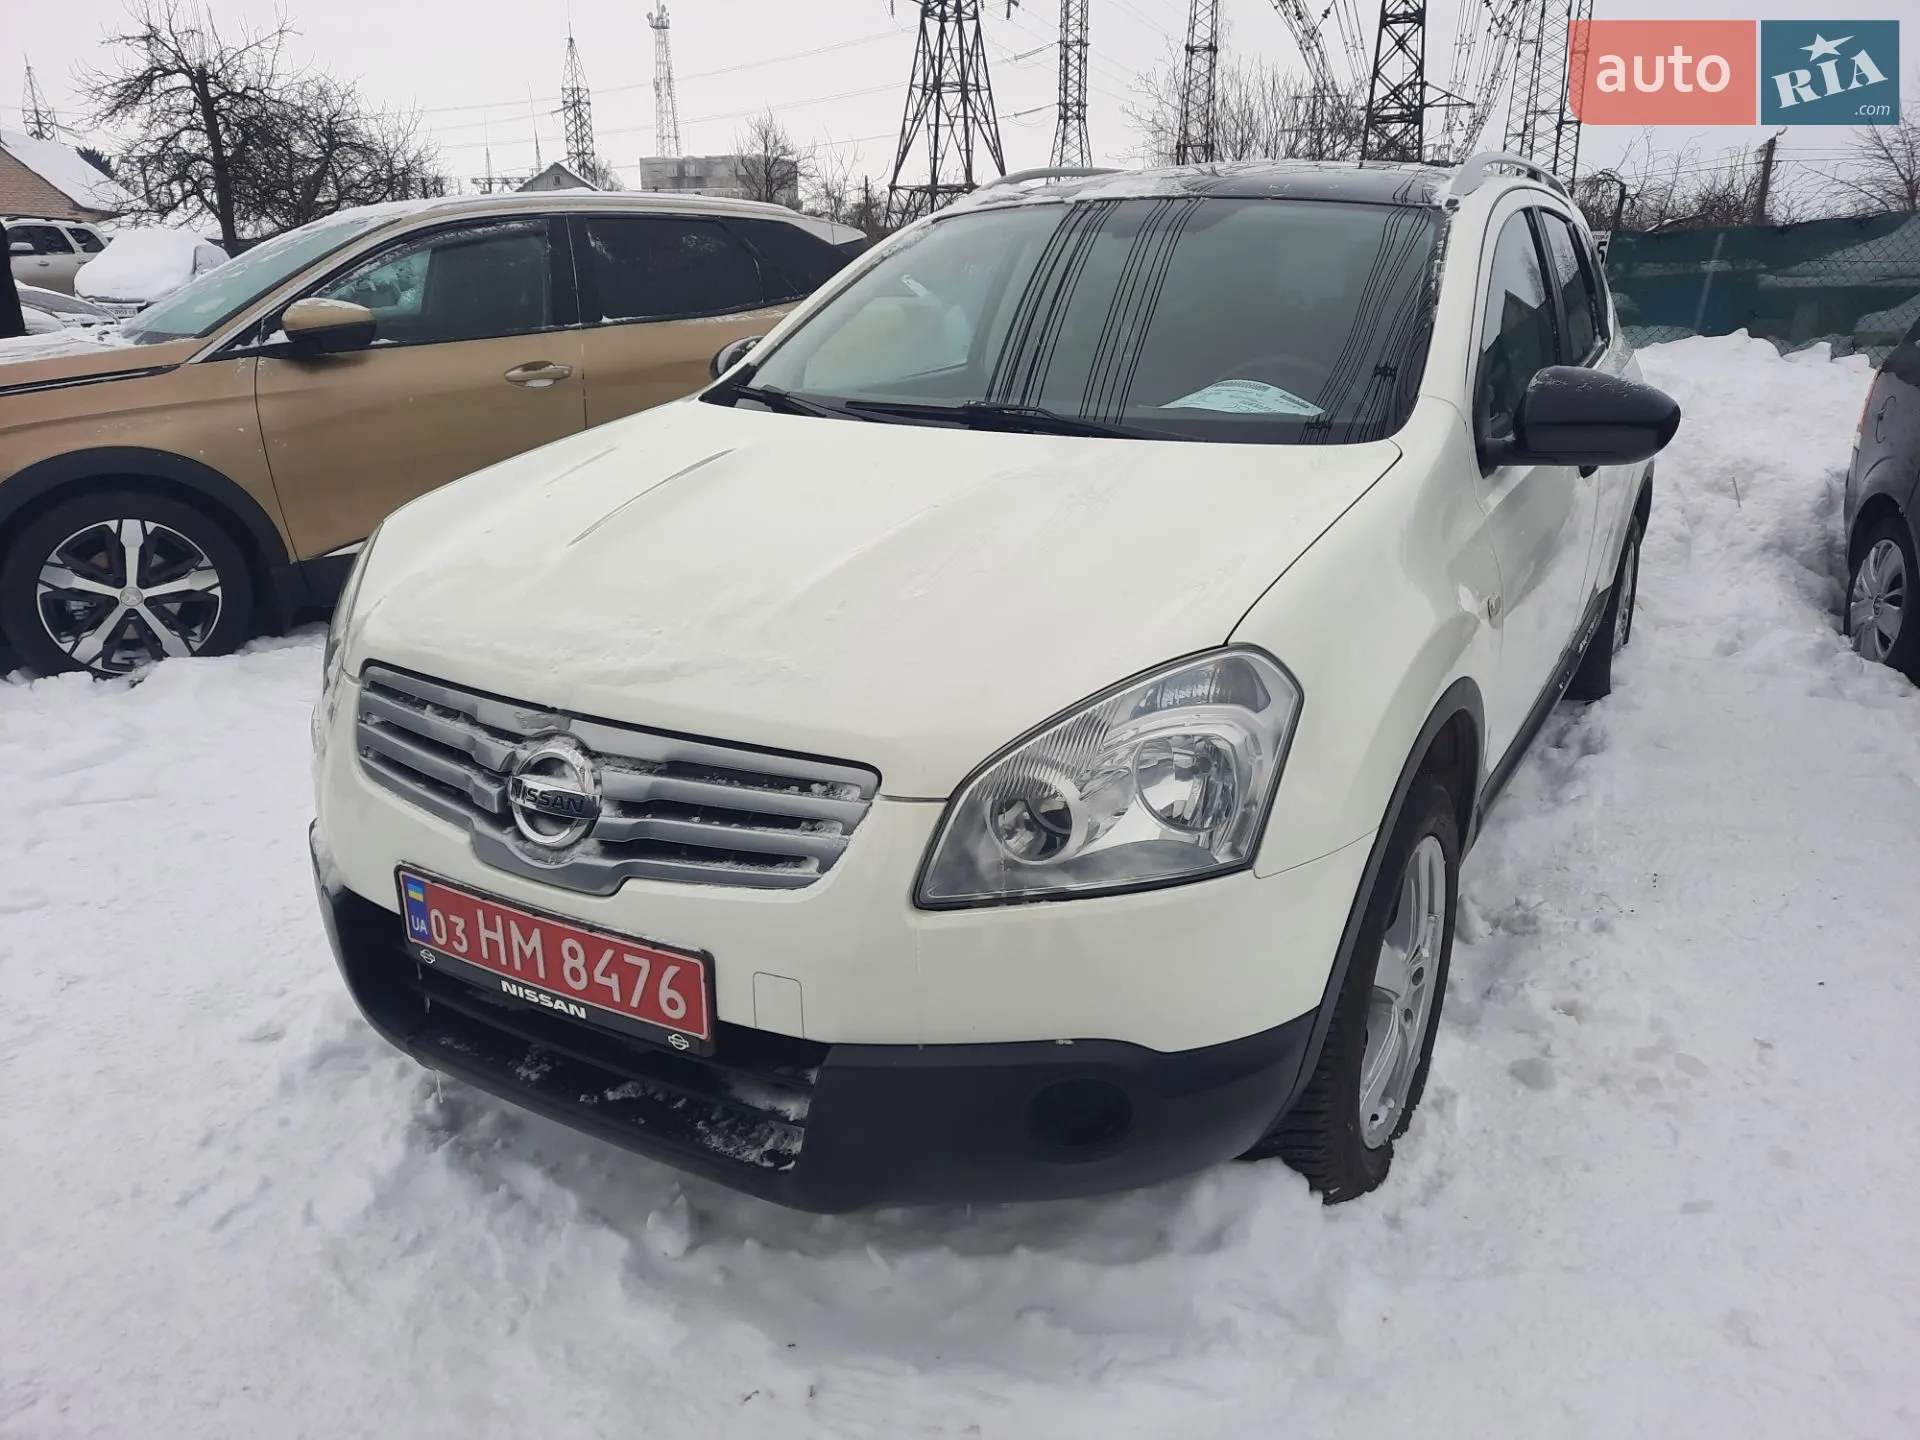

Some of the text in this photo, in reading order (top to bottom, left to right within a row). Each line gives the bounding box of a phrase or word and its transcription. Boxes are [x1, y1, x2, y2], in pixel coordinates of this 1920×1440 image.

[510, 778, 583, 816] NISSAN
[411, 915, 428, 935] UA
[430, 908, 687, 1021] 03 HM 8476
[500, 980, 587, 1020] NISSAN
